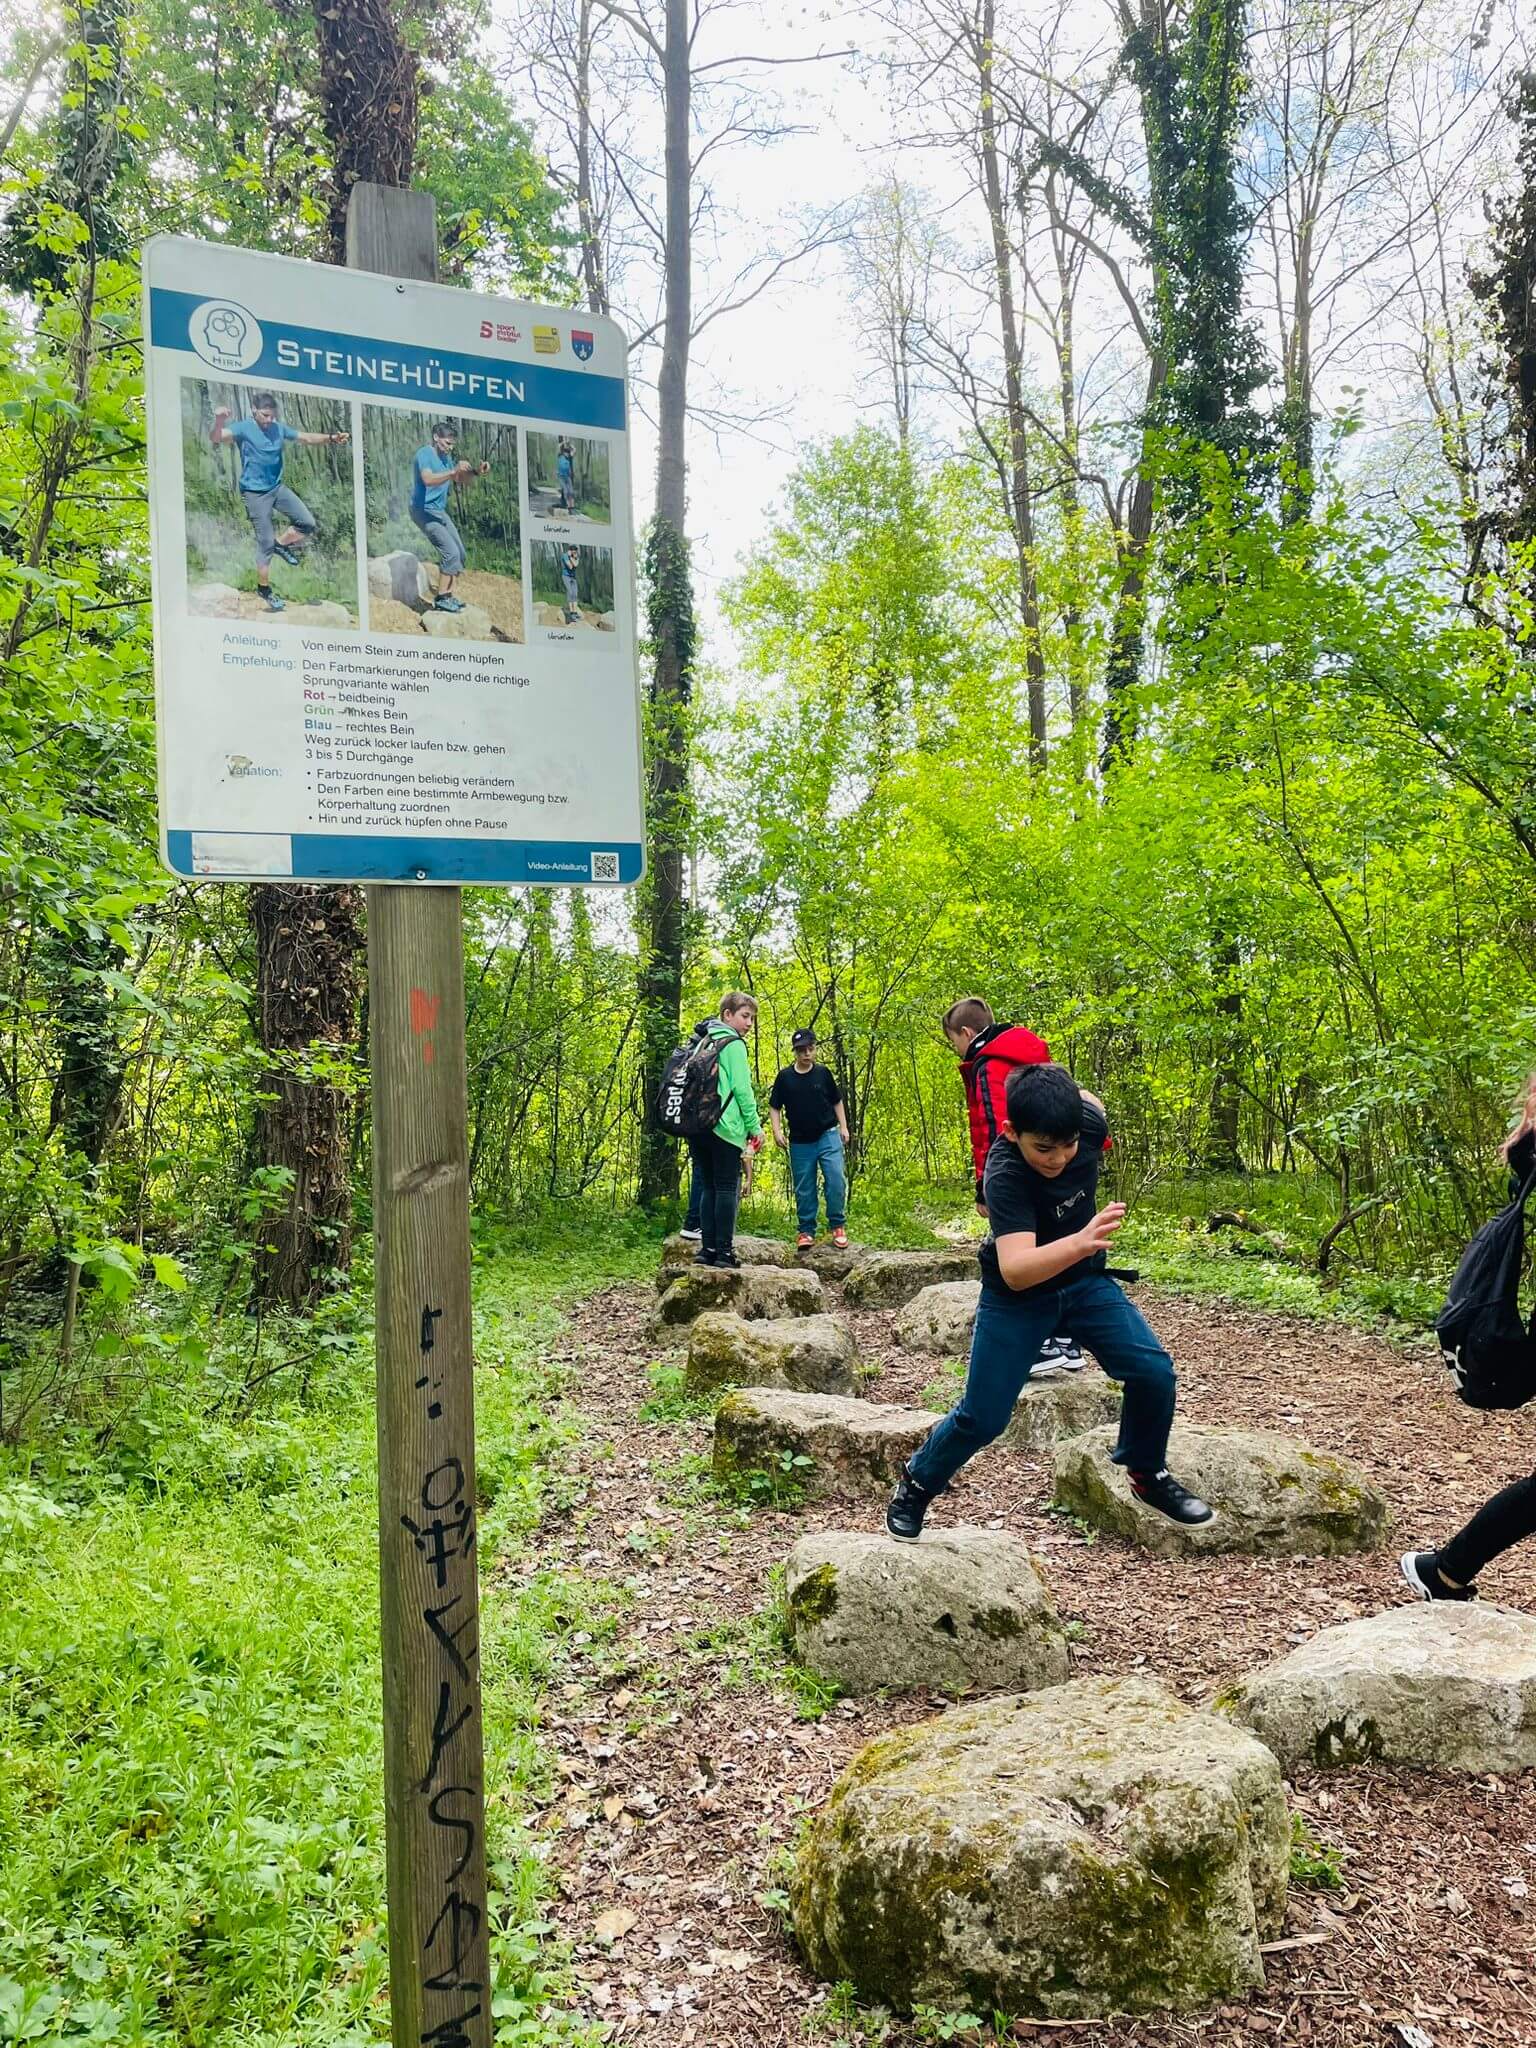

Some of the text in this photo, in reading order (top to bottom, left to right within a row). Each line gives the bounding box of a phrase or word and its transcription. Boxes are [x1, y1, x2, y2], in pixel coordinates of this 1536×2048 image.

[213, 356, 242, 367] HIRN
[222, 633, 504, 666] Anleitung: Von einem Stein zum anderen hüpfen
[222, 653, 530, 687] Empfehlung: Den Farbmarkierungen folgend die richtige
[303, 675, 430, 693] Sprungvariante wählen
[304, 690, 325, 700] Rot
[338, 692, 395, 706] beidbeinig
[304, 704, 334, 716] Grün
[383, 709, 408, 721] Bein
[304, 719, 332, 731] Blau
[346, 722, 387, 734] rechtes
[390, 723, 415, 735] Bein
[305, 734, 506, 756] Weg zurück locker laufen bzw. gehen
[305, 749, 414, 766] 3 bis 5 Durchgänge
[317, 769, 415, 784] Farbzuordnungen
[418, 774, 459, 787] beliebig
[462, 776, 515, 787] verändern
[317, 784, 570, 805] Den Farben eine bestimmte Armbewegung bzw.
[318, 798, 450, 813] Körperhaltung zuordnen
[319, 813, 508, 829] Hin und zurück hüpfen ohne Pause
[527, 861, 588, 872] Video-Anleitung
